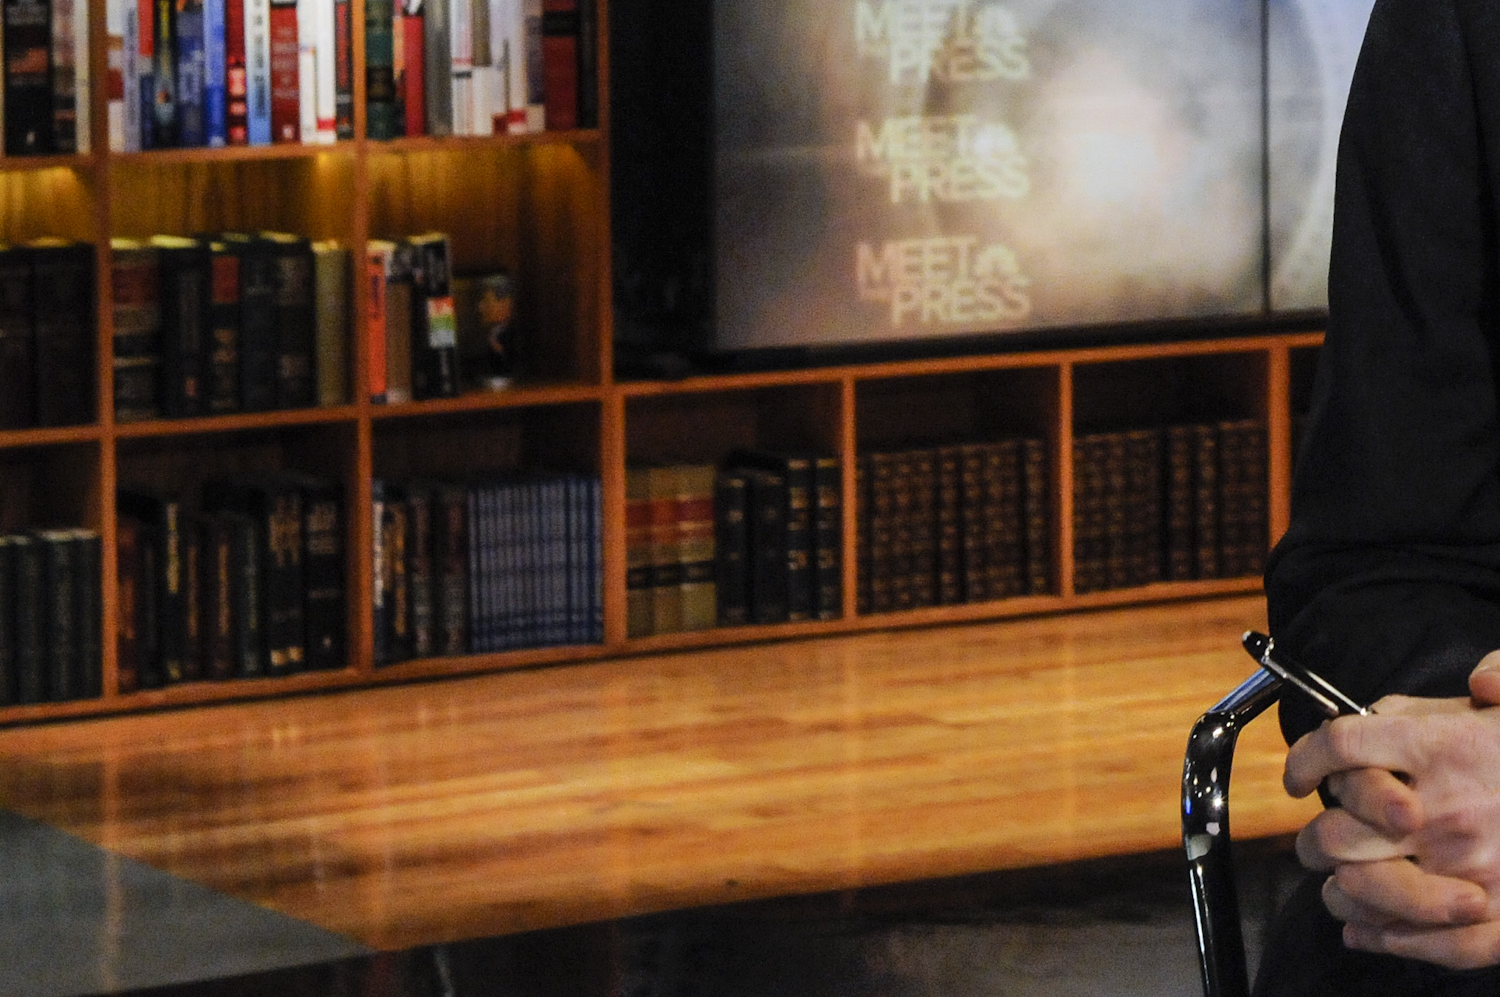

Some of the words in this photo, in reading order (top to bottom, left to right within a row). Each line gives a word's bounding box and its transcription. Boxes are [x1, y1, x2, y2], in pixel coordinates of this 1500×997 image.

[856, 114, 977, 161] MEET
[890, 153, 1030, 204] PRESS
[856, 236, 977, 286] MEET
[890, 275, 1030, 326] PRESS
